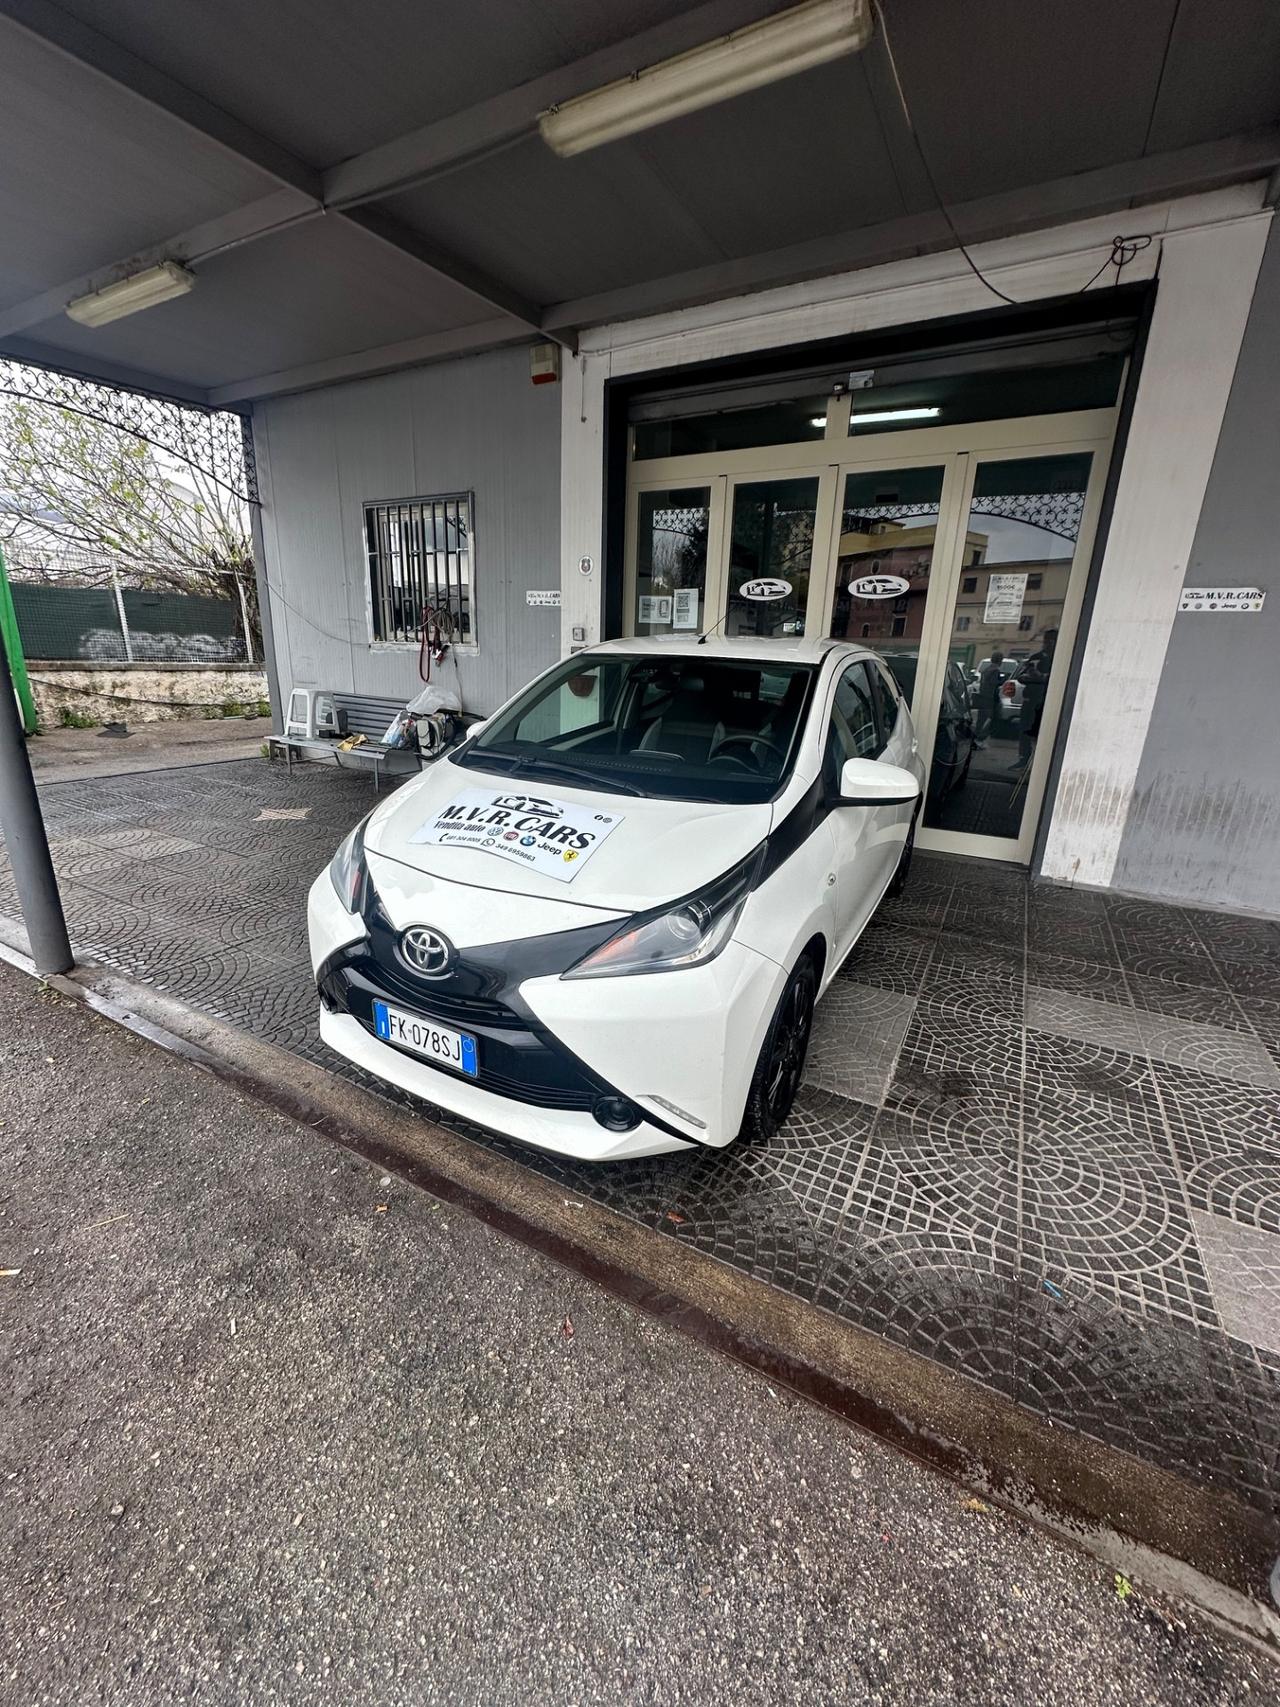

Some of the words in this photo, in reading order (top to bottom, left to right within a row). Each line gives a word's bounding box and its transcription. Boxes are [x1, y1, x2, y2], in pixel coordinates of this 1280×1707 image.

[433, 820, 465, 831] Vendita
[464, 823, 486, 832] auto
[537, 842, 562, 856] Jeep
